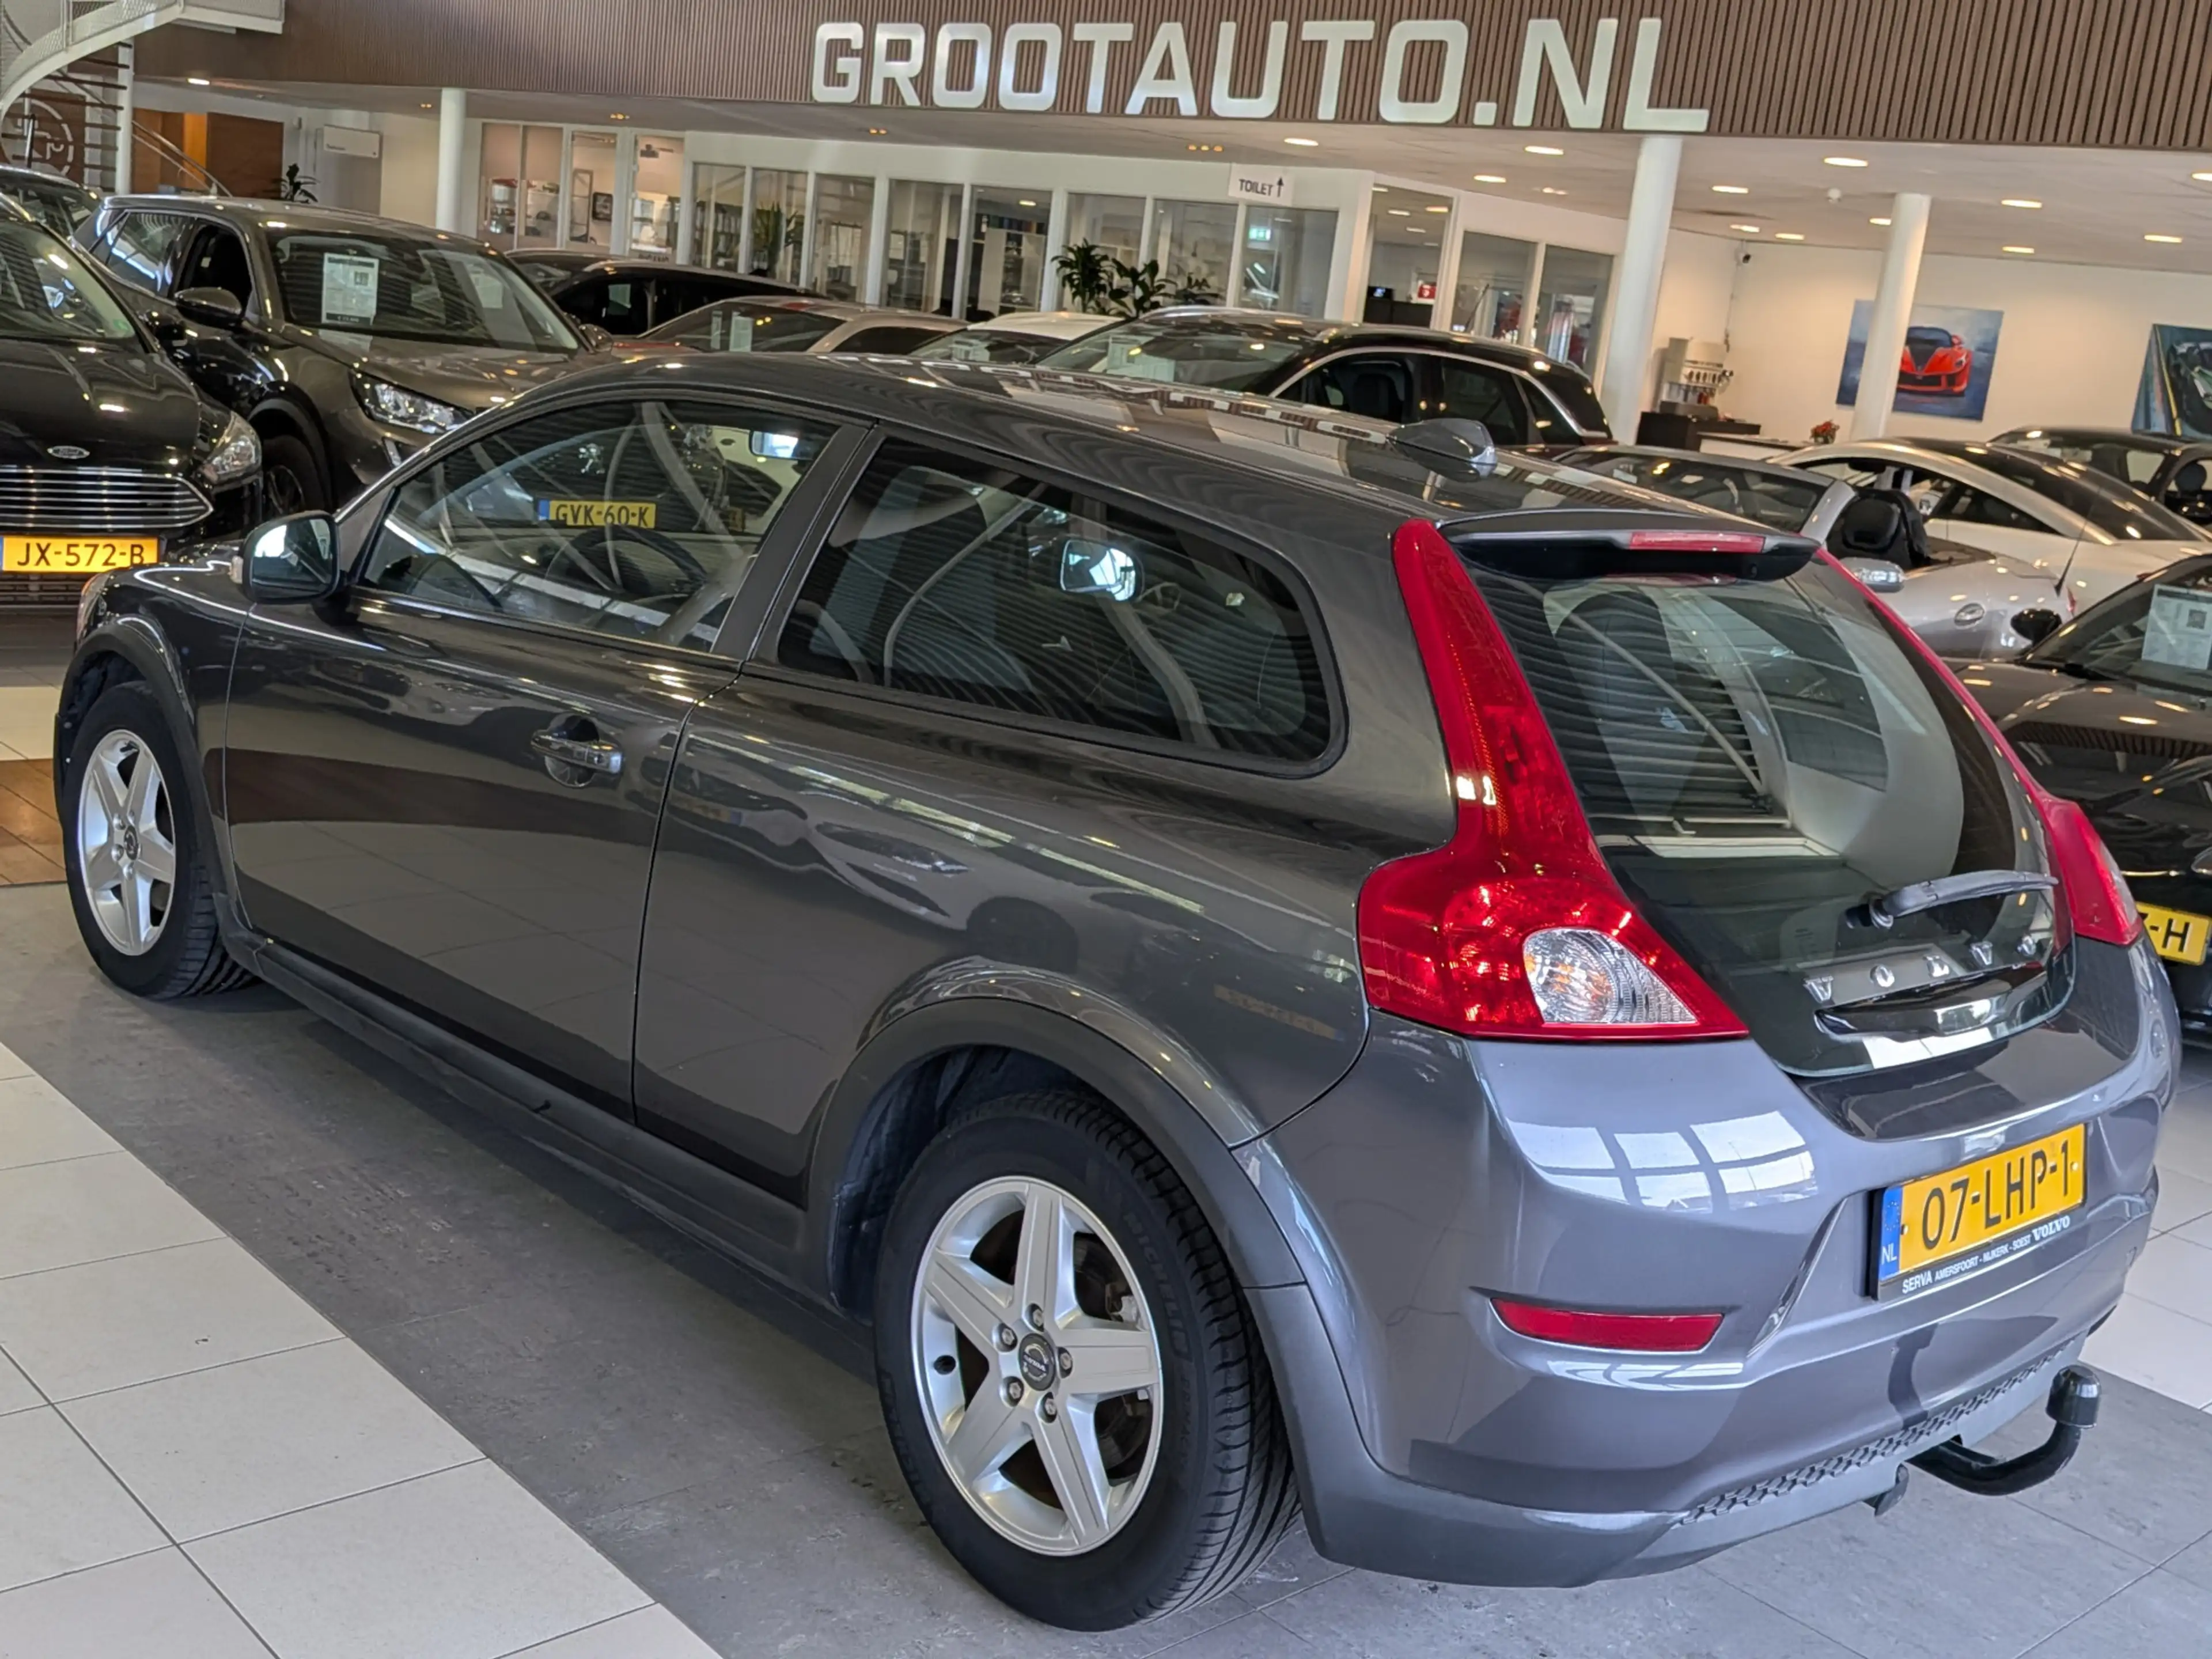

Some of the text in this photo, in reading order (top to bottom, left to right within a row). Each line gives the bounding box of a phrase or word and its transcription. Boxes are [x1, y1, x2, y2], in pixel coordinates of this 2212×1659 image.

[812, 17, 1710, 132] GROOTAUTO.NL
[1238, 178, 1274, 196] TOILET
[556, 503, 649, 527] GVK-60-K
[17, 542, 145, 566] JX-572-B
[2137, 912, 2190, 953] -H
[1804, 934, 2037, 1005] VOLVO
[1922, 1139, 2069, 1251] 07-LHP-1
[1881, 1242, 1897, 1266] NL
[1902, 1270, 1933, 1294] SERVA
[1934, 1255, 1979, 1282] AMERSFOORT
[2012, 1234, 2031, 1251] SOEST
[2032, 1215, 2071, 1241] VOLVO
[1123, 1213, 1190, 1358] MICHELIN
